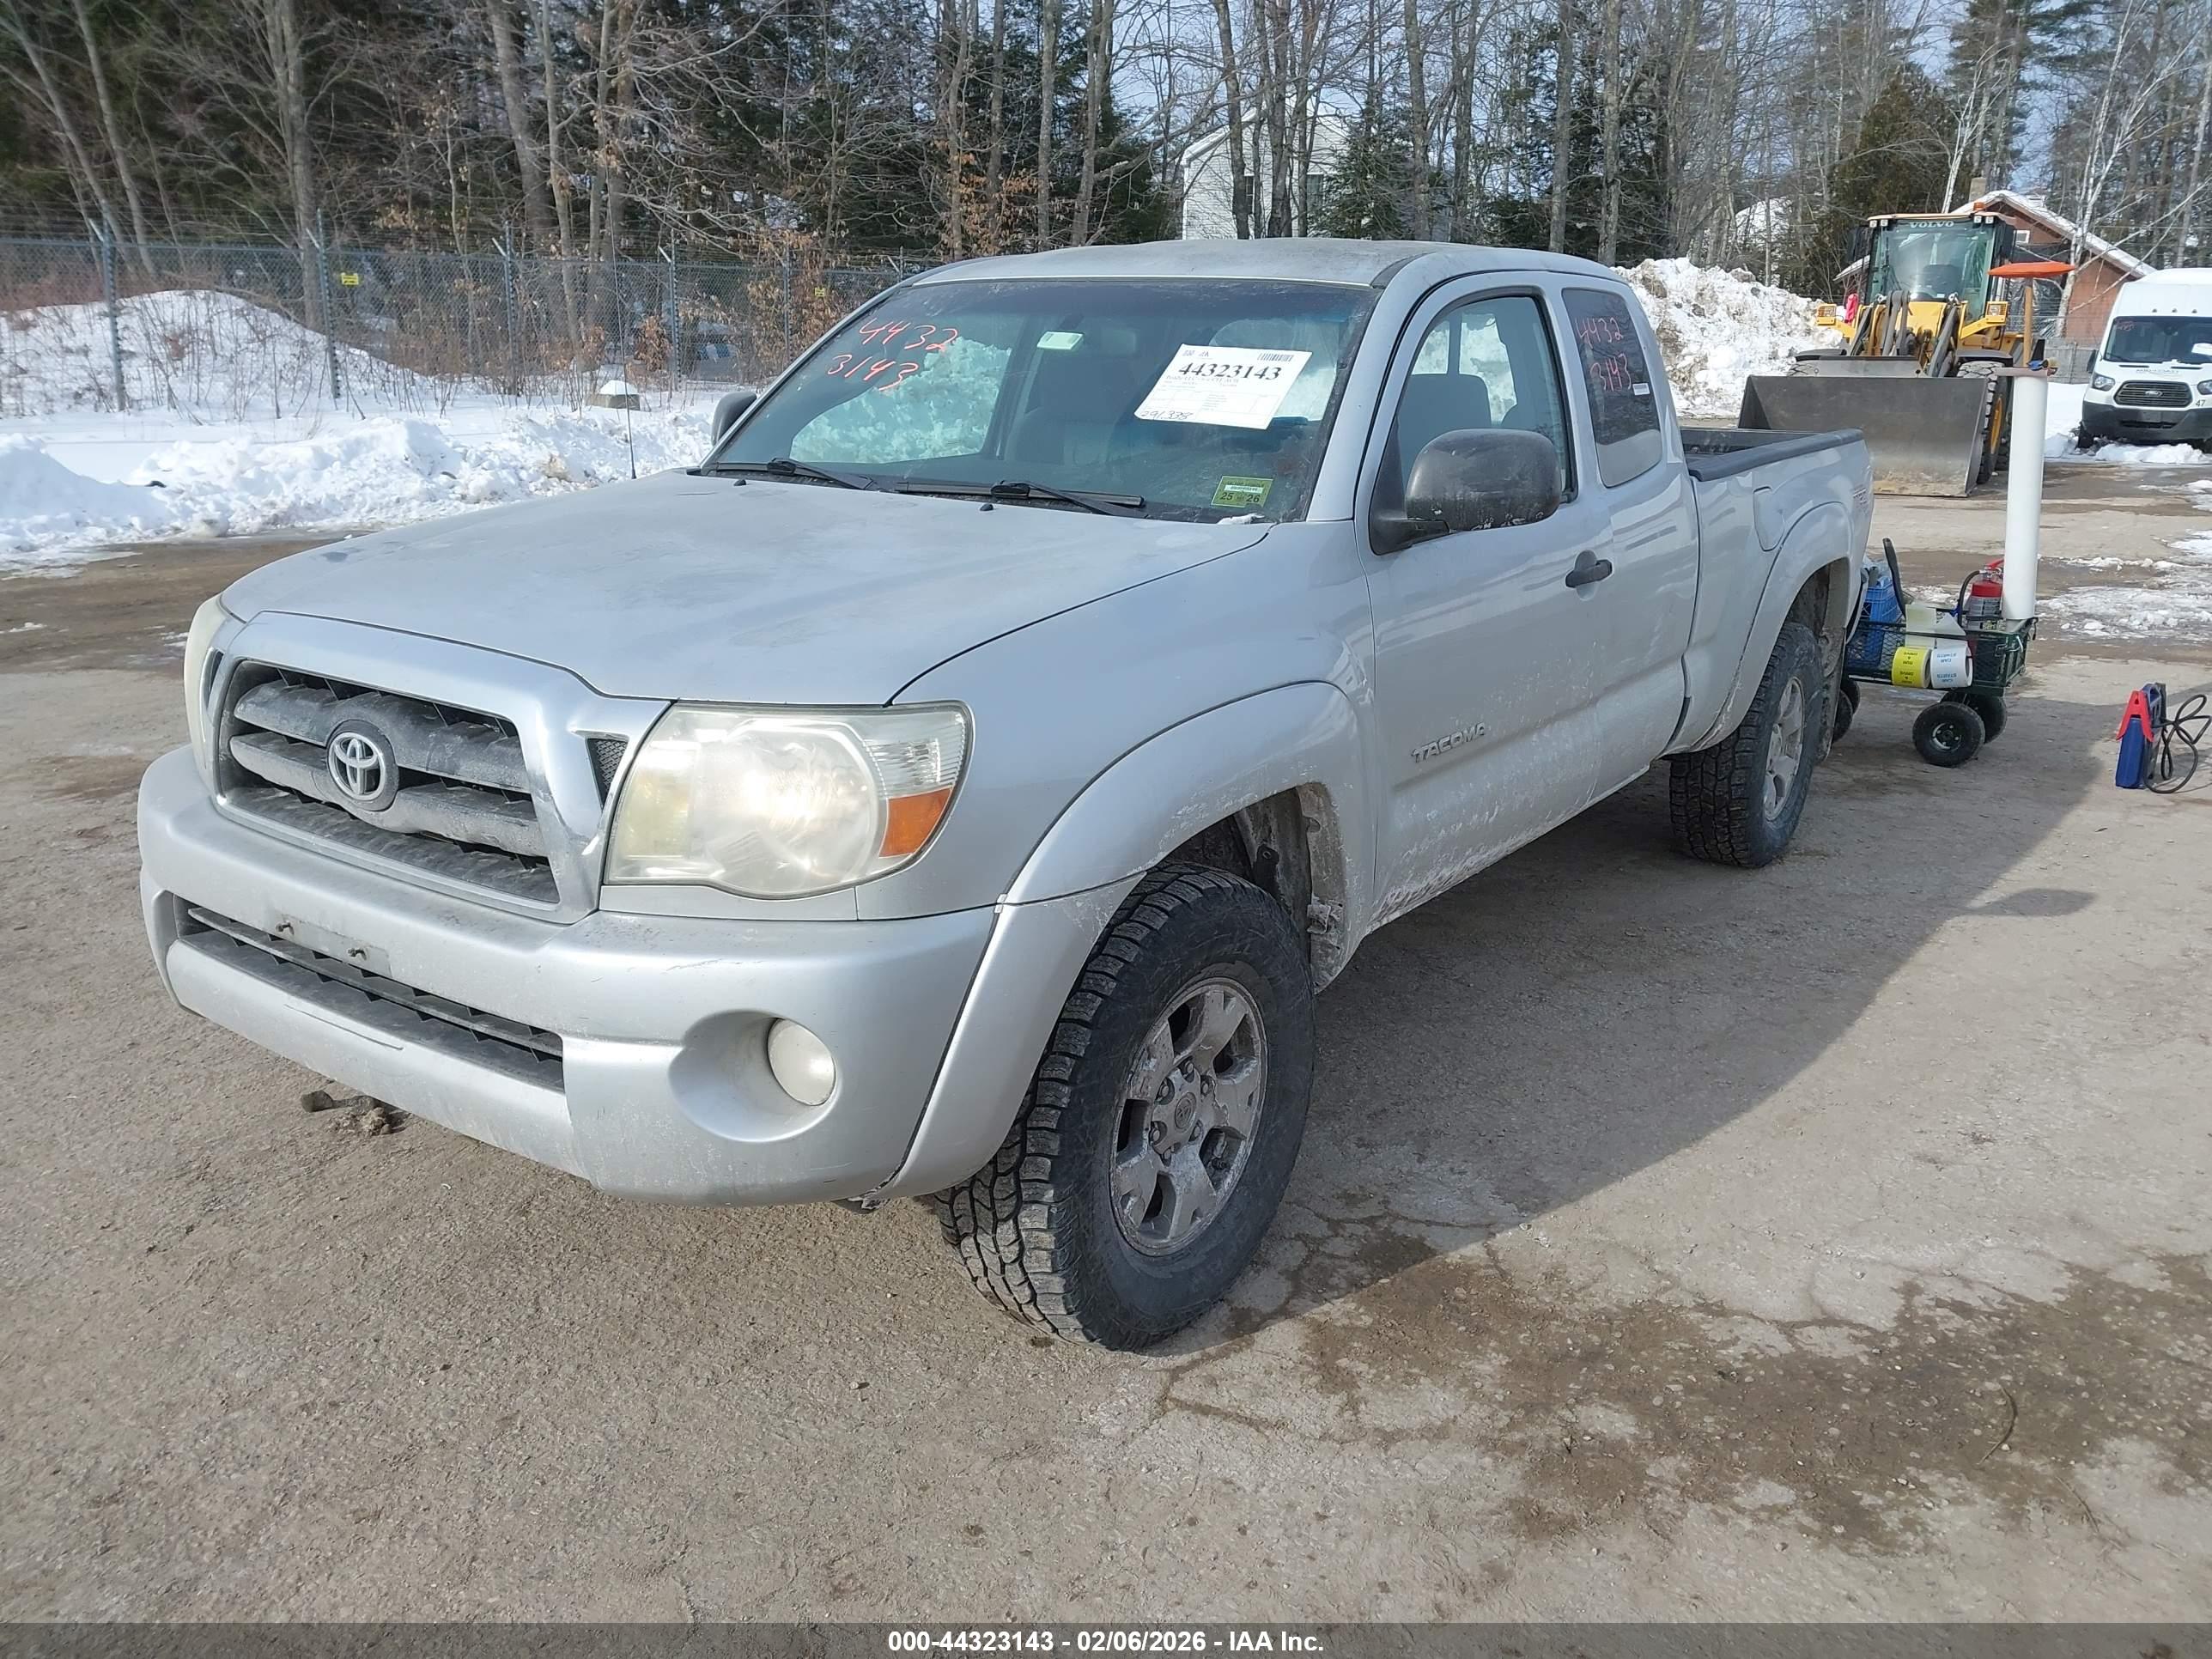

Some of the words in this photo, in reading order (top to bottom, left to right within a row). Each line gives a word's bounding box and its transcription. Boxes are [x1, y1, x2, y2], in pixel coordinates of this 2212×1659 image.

[859, 318, 959, 350] 4432
[1575, 317, 1624, 349] 4432
[828, 354, 919, 392] 3143
[1178, 362, 1282, 380] 44323143
[1589, 352, 1632, 392] 3143
[1220, 492, 1235, 501] 25
[1245, 494, 1261, 503] 26
[1411, 721, 1486, 763] TACOMA
